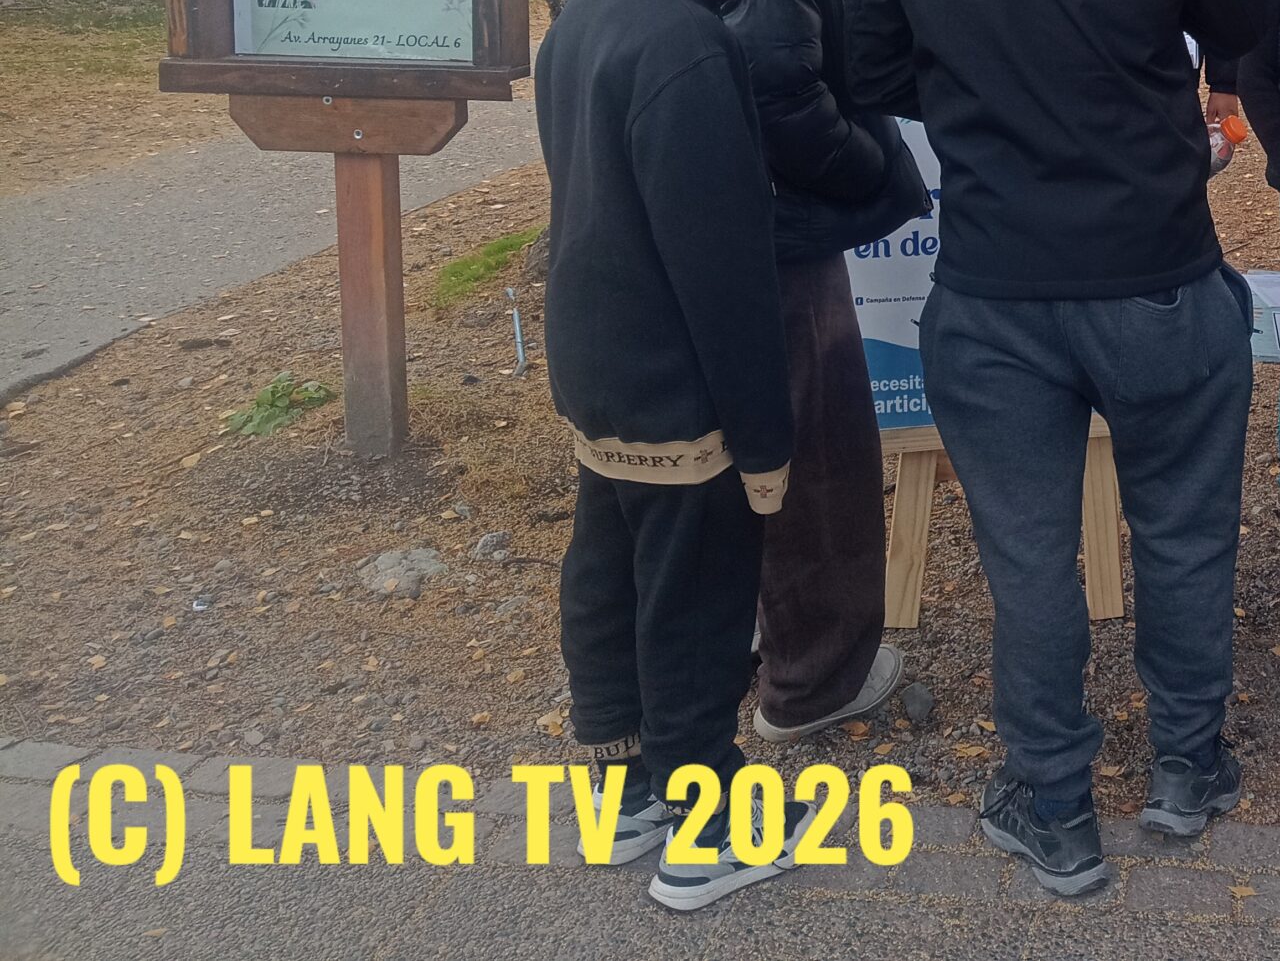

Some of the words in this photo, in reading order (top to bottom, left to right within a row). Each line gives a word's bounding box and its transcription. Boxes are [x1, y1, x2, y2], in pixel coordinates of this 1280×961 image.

[280, 31, 301, 43] Av.
[304, 32, 369, 51] Arrayanes
[395, 35, 450, 48] LOCAL
[453, 38, 462, 48] 6
[871, 375, 924, 391] ecesit
[874, 393, 932, 414] artici
